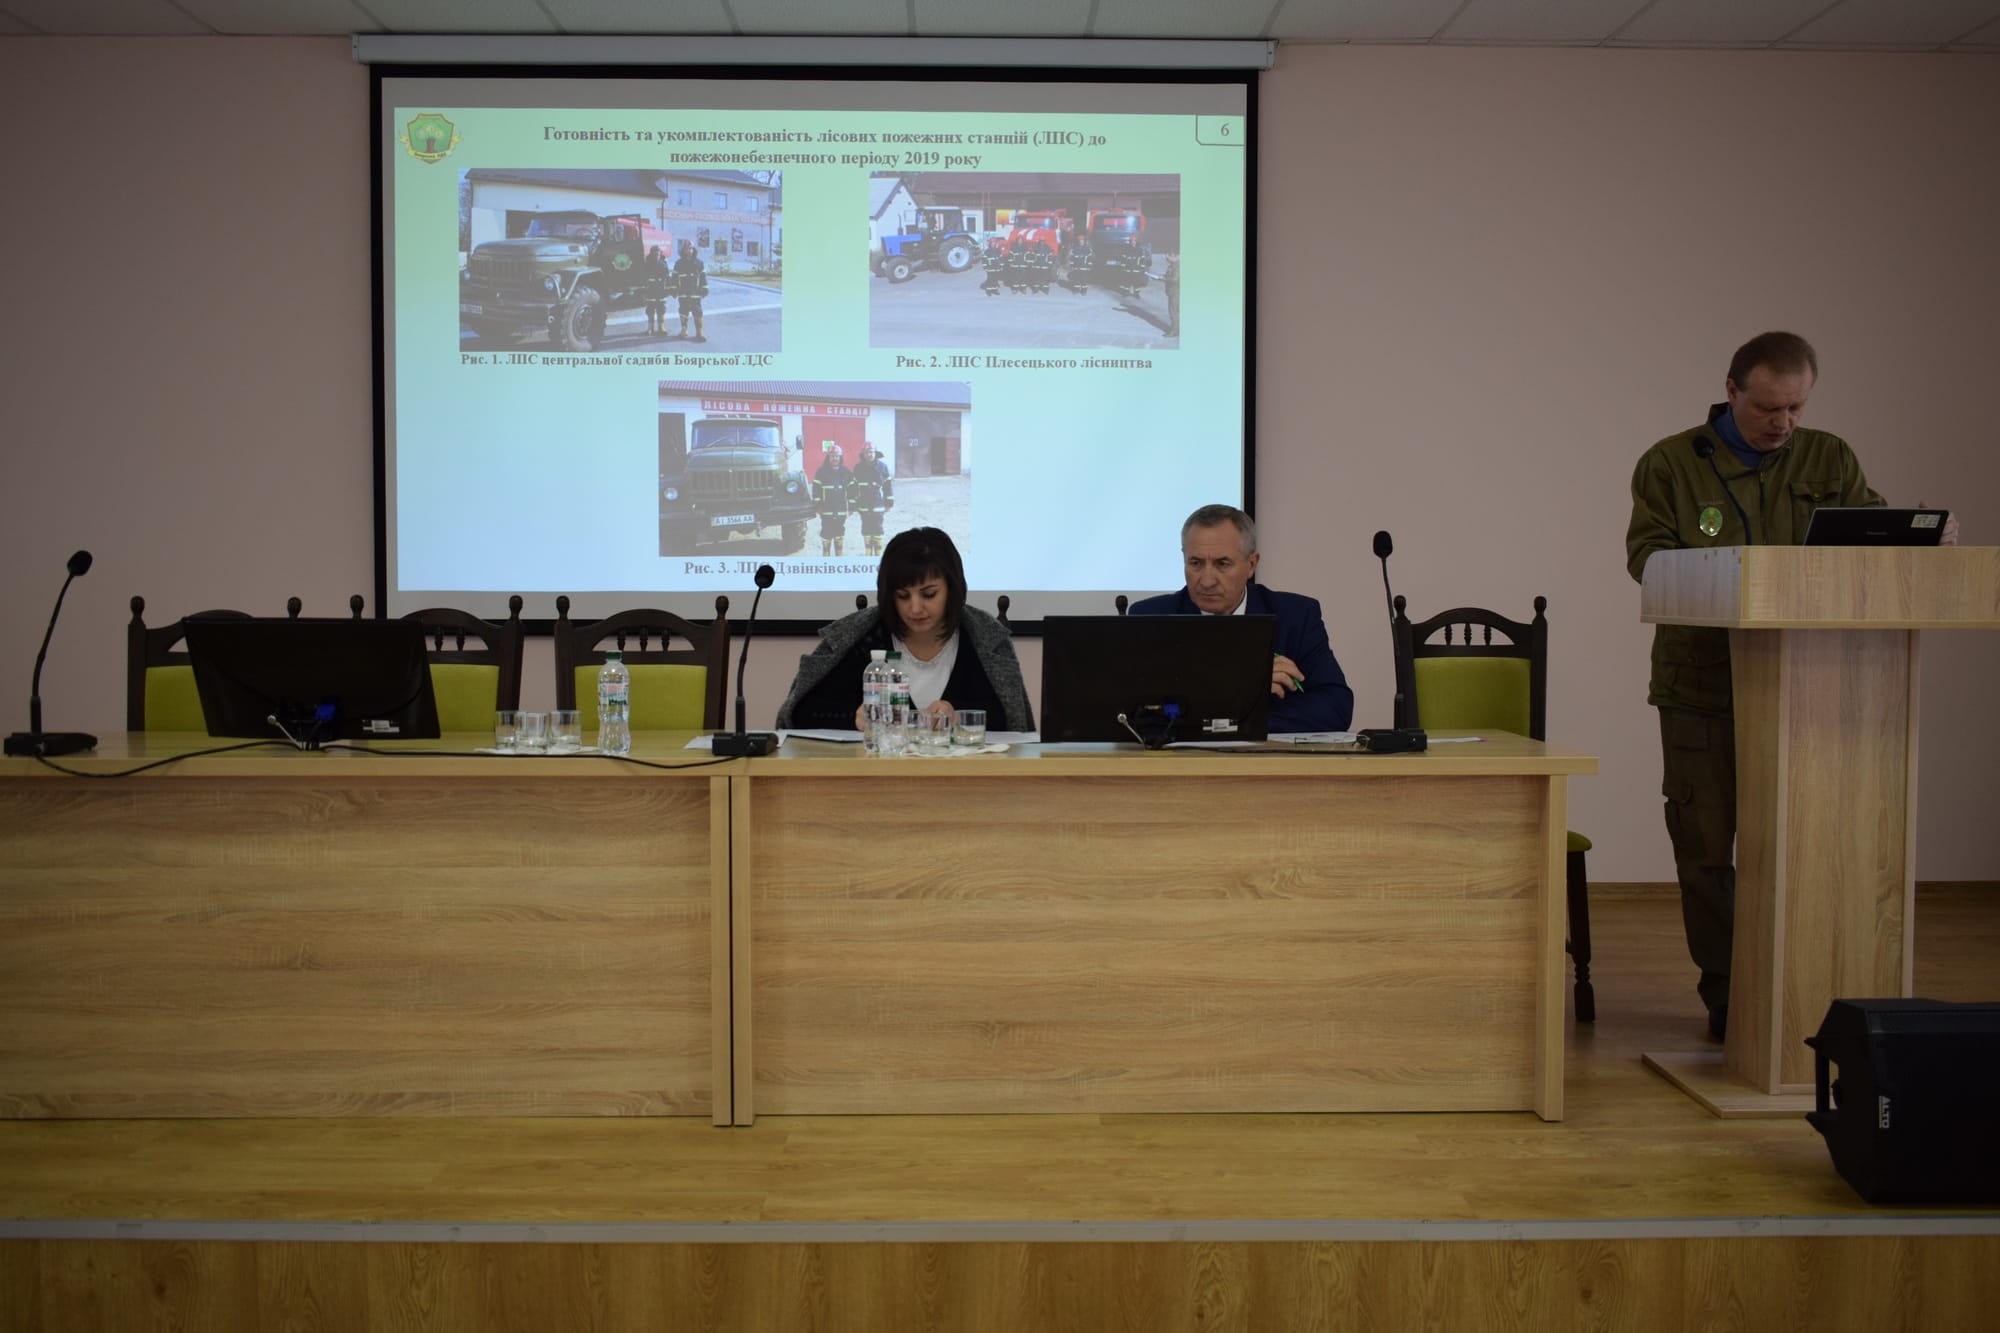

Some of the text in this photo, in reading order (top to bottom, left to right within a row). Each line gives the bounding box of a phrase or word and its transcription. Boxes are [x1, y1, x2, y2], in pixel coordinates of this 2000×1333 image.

[543, 126, 1107, 147] Готовність та укомплектованість лісових пожежних станцій (ЛПС) до
[1220, 122, 1230, 137] 6
[670, 150, 982, 169] пожежонебезпечного періоду 2019 року
[461, 353, 774, 368] Рис. 1. ЛПС центральної садиби Боярської ЛДС
[895, 355, 1153, 370] Рис. 2. ЛПС Плесецького лісництва
[684, 562, 714, 574] Рис.
[717, 562, 731, 574] 3.
[1881, 1096, 1891, 1128] ALTO
